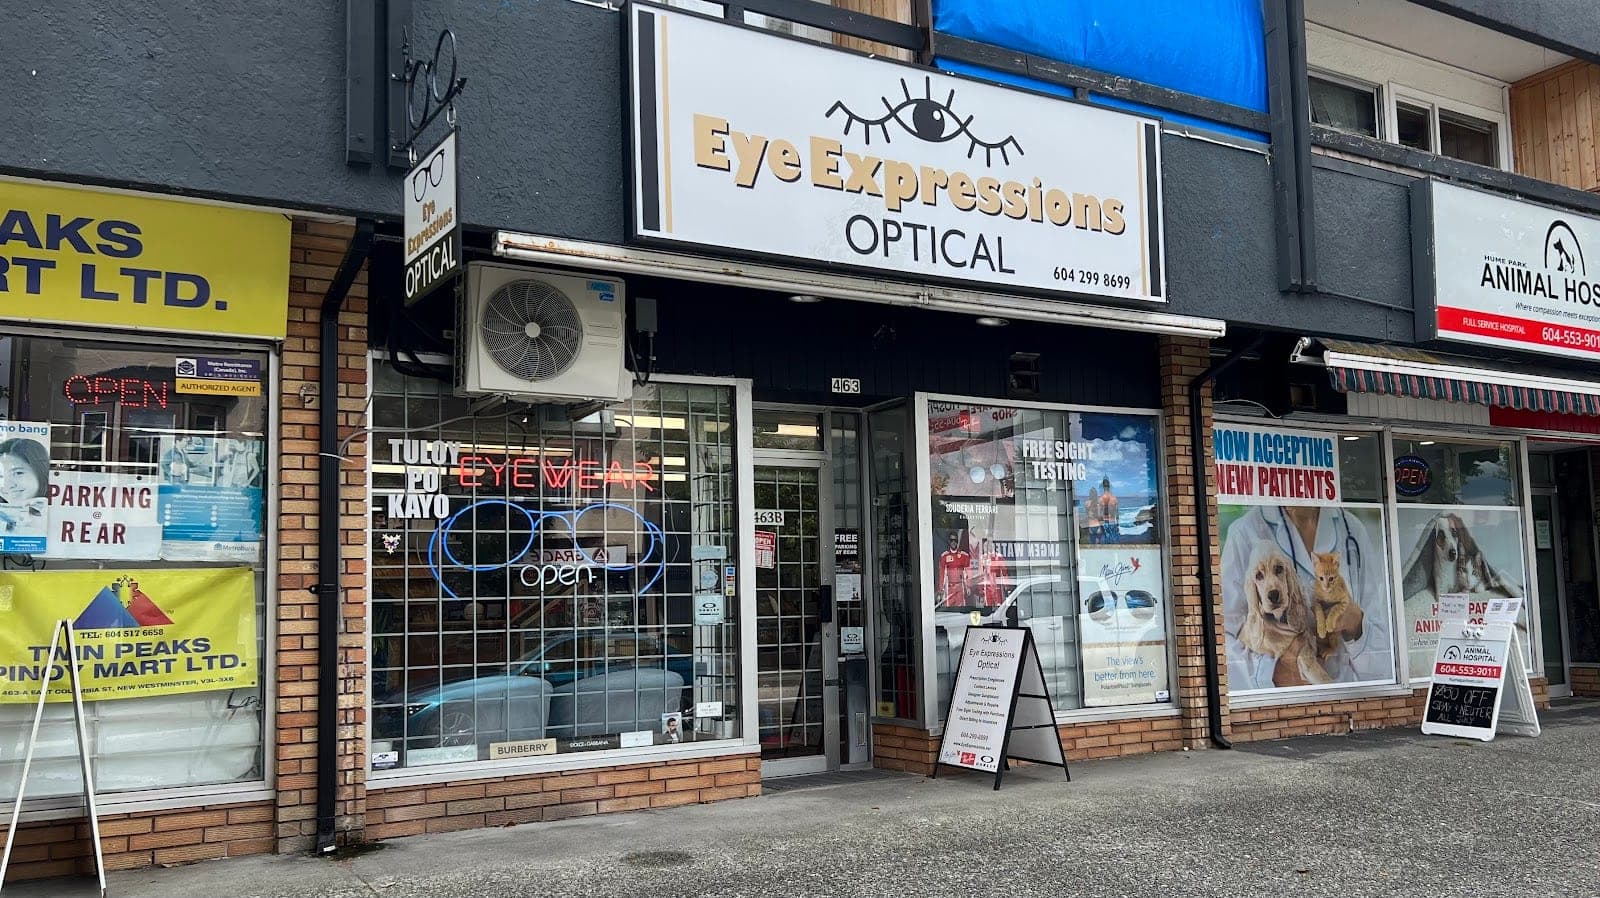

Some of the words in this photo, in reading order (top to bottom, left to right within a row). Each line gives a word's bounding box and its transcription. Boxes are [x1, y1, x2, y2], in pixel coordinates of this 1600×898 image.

[692, 113, 802, 188] Eye
[810, 136, 1127, 235] Expressions
[0, 209, 144, 259] AKS
[845, 214, 1016, 275] OPTICAL
[405, 236, 457, 298] OPTICAL
[1484, 255, 1506, 264] HUME
[1508, 259, 1528, 268] PARK
[80, 263, 228, 311] LTD.
[1052, 266, 1075, 282] 604
[1079, 270, 1099, 286] 299
[1101, 273, 1131, 289] 8699
[1480, 263, 1559, 300] ANIMAL
[1463, 317, 1477, 328] FULL
[1478, 319, 1500, 331] SERVICE
[1500, 322, 1526, 335] HOSPITAL
[65, 373, 168, 409] OPEN
[181, 383, 229, 392] AUTHORIZED
[832, 379, 859, 392] 463
[18, 424, 48, 436] bang
[388, 438, 461, 465] TULOY
[1022, 440, 1054, 458] FREE
[1055, 441, 1093, 460] SIGHT
[1214, 430, 1250, 462] NOW
[1253, 432, 1334, 467] ACCEPTING
[407, 468, 438, 493] PO
[459, 456, 655, 491] EYEWEAR
[1032, 461, 1086, 480] TESTING
[1395, 467, 1428, 485] OPEN
[1216, 463, 1254, 495] NEW
[1258, 466, 1336, 500] PATIENTS
[48, 484, 152, 508] PARKING
[92, 511, 103, 519] @
[388, 494, 450, 519] KAYO
[61, 520, 127, 545] REAR
[835, 534, 858, 543] FREE
[520, 564, 593, 591] open
[80, 631, 102, 639] TEL:
[105, 630, 121, 638] 604
[142, 628, 164, 636] 6658
[28, 645, 104, 661] TWIN
[115, 637, 211, 659] PEAKS
[969, 648, 980, 658] Eye
[981, 649, 1015, 659] Expressions
[1463, 654, 1497, 662] HOSPITAL
[1464, 647, 1491, 655] ANIMAL
[93, 658, 177, 679] MART
[186, 654, 246, 672] LTD.
[977, 659, 1000, 670] Optical
[1106, 656, 1120, 666] The
[1121, 656, 1144, 665] view's
[1440, 664, 1497, 677] 604-553-9011
[1094, 671, 1117, 682] better
[1120, 670, 1137, 680] from
[1463, 690, 1492, 707] OFF
[497, 743, 548, 755] BURBERRY
